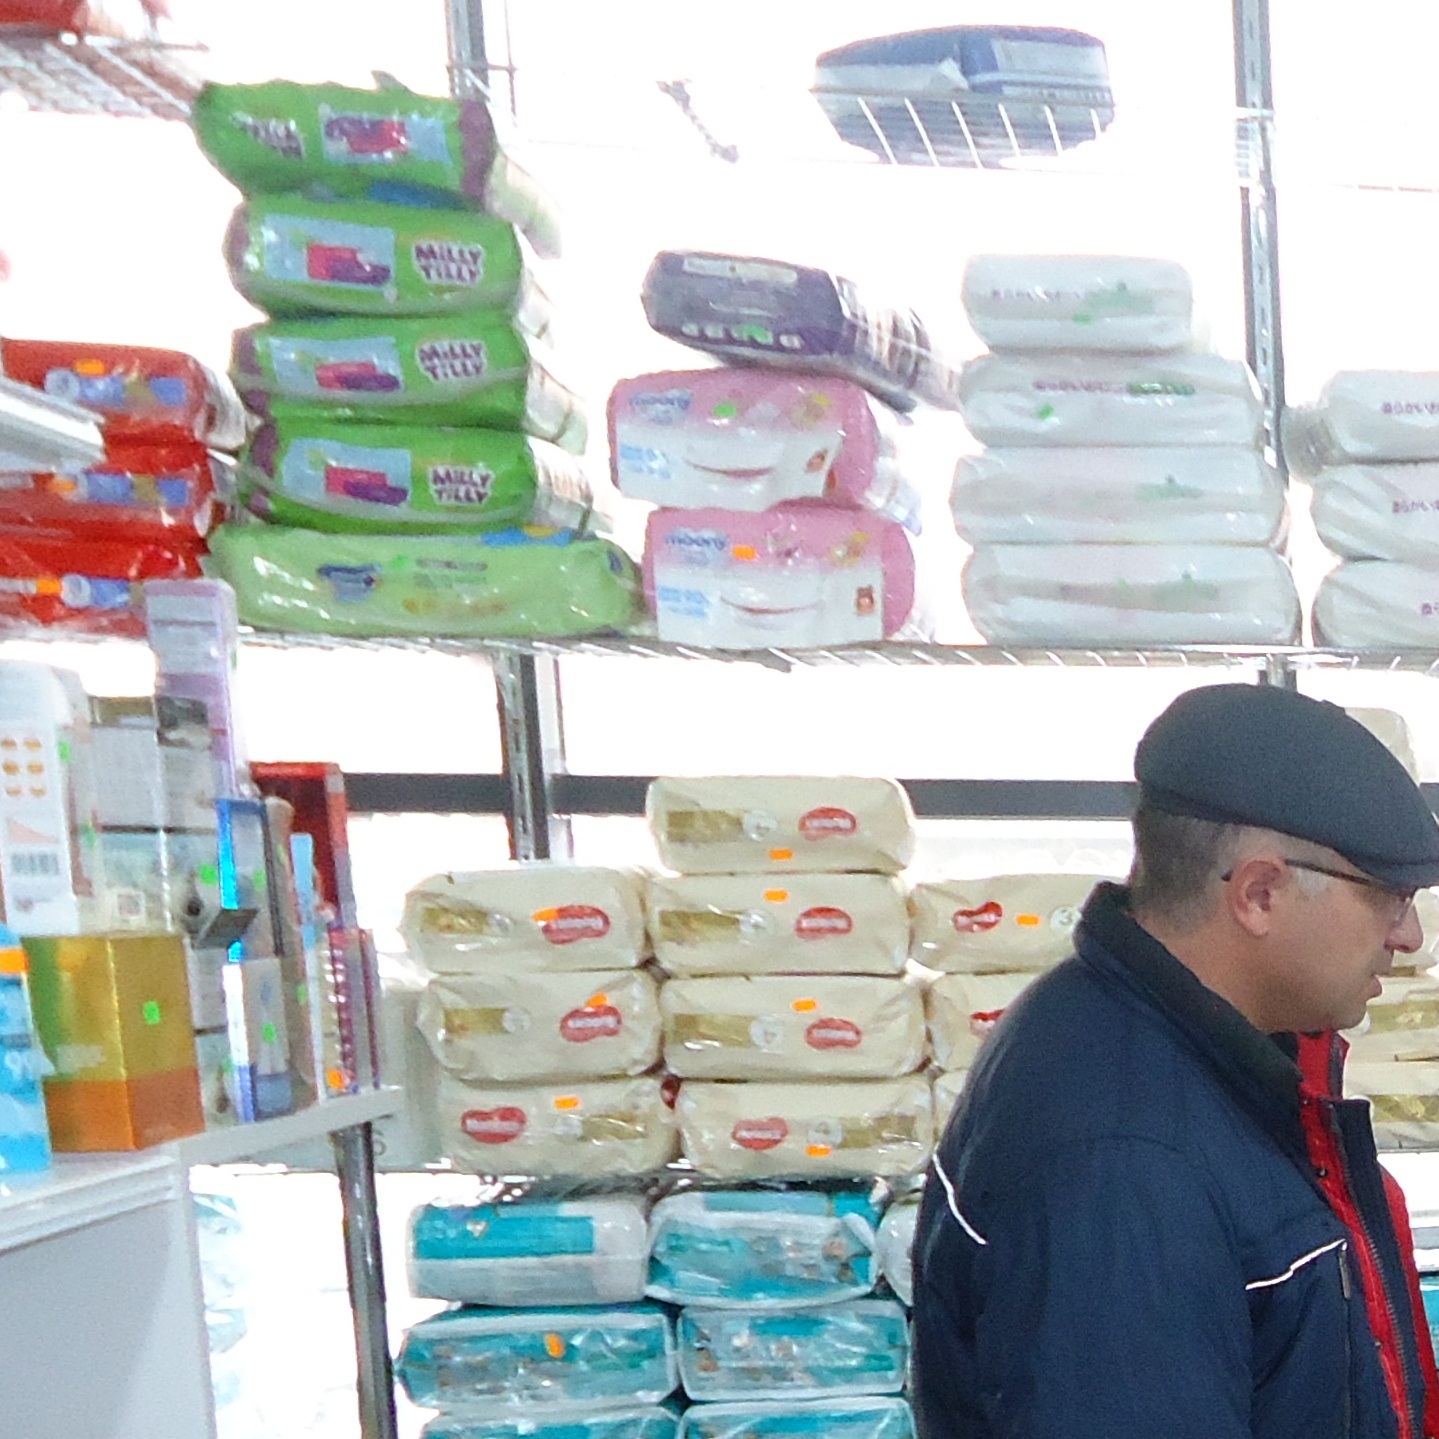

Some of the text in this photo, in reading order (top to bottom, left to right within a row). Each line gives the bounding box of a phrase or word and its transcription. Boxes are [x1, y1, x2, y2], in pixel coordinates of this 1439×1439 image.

[415, 244, 482, 264] MILLY
[418, 342, 483, 361] MILLY
[431, 467, 491, 487] MILLY
